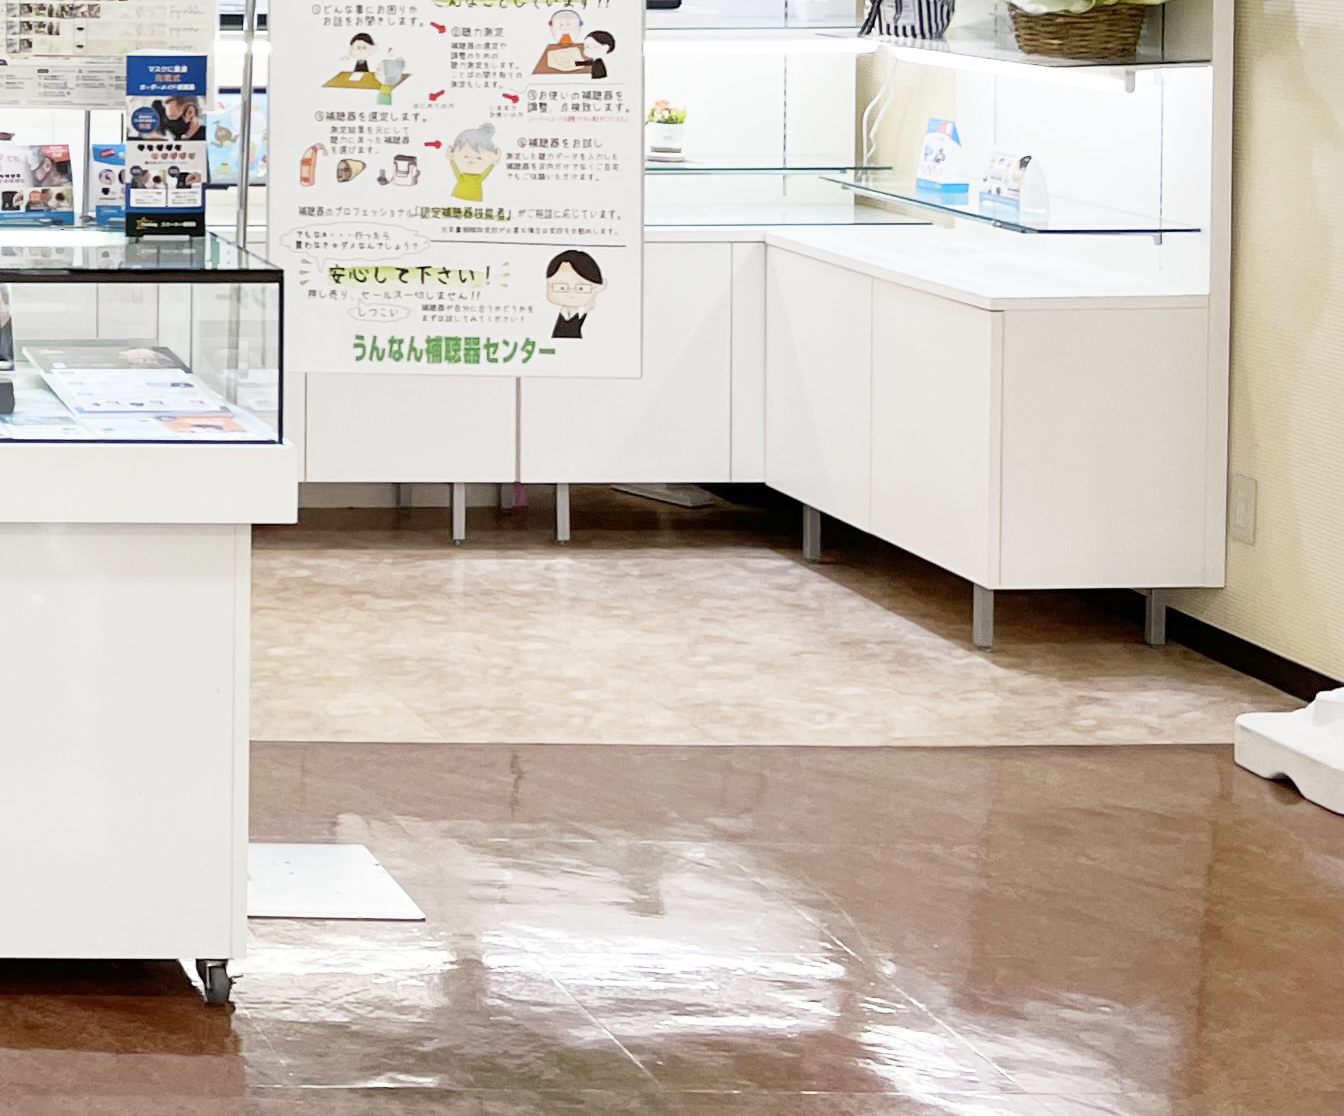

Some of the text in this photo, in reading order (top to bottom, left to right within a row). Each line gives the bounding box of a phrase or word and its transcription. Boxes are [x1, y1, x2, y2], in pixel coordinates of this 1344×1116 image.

[328, 264, 492, 285] 安心して下さい!
[352, 333, 557, 366] うんなん補聴器センター
